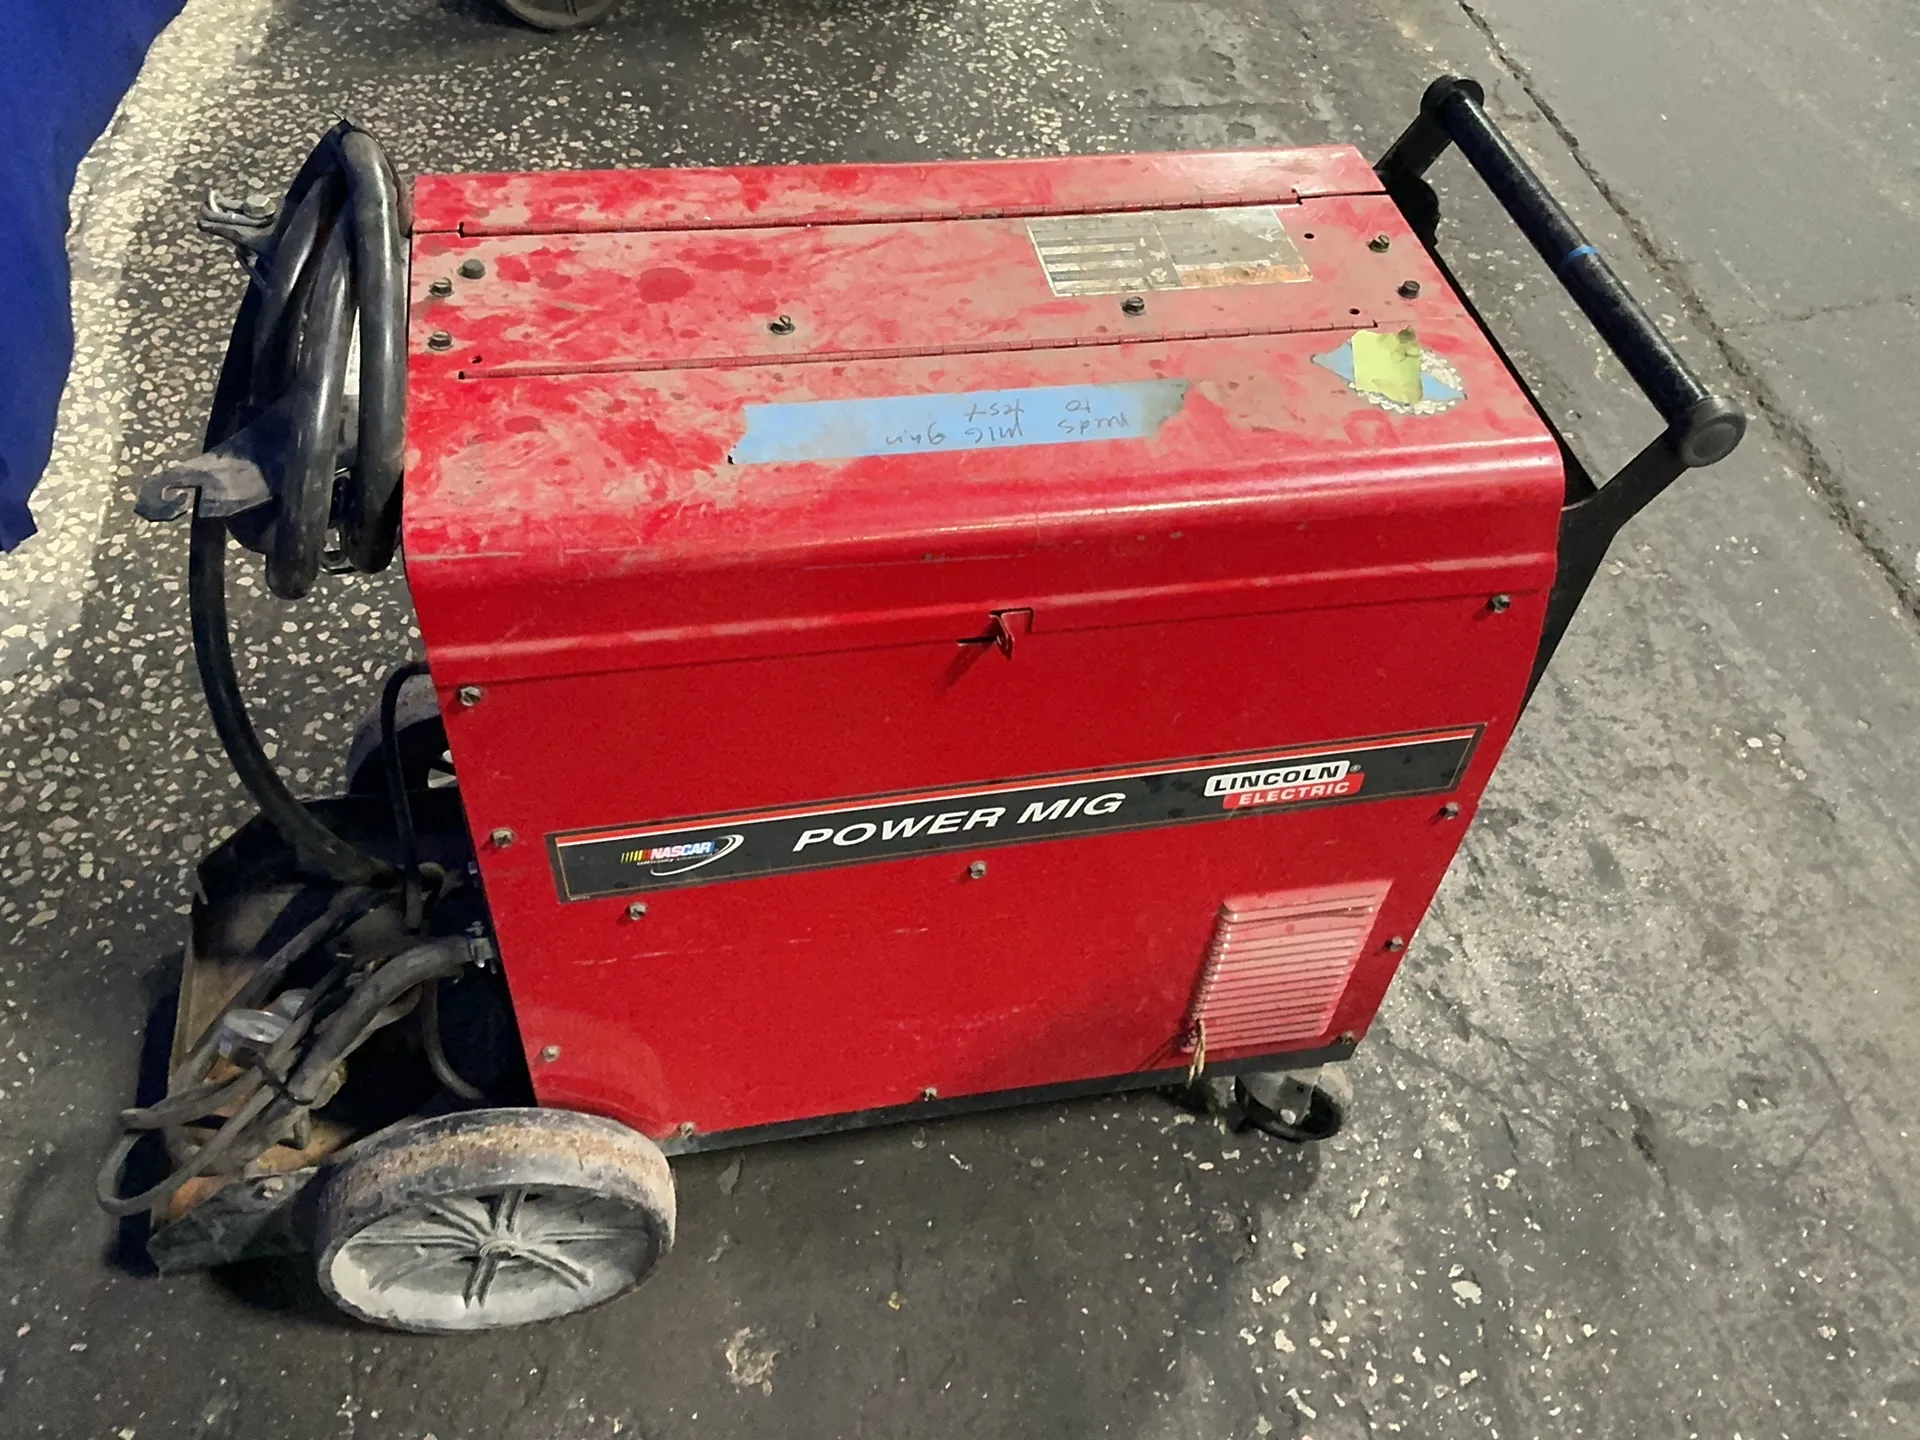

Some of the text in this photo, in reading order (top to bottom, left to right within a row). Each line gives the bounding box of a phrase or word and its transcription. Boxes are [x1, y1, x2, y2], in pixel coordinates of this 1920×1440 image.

[963, 398, 1091, 422] to test
[1213, 765, 1341, 792] LINCOLN
[1238, 781, 1351, 806] ELECTRIC
[792, 793, 1126, 852] POWER MIG
[650, 841, 712, 860] NASCAR
